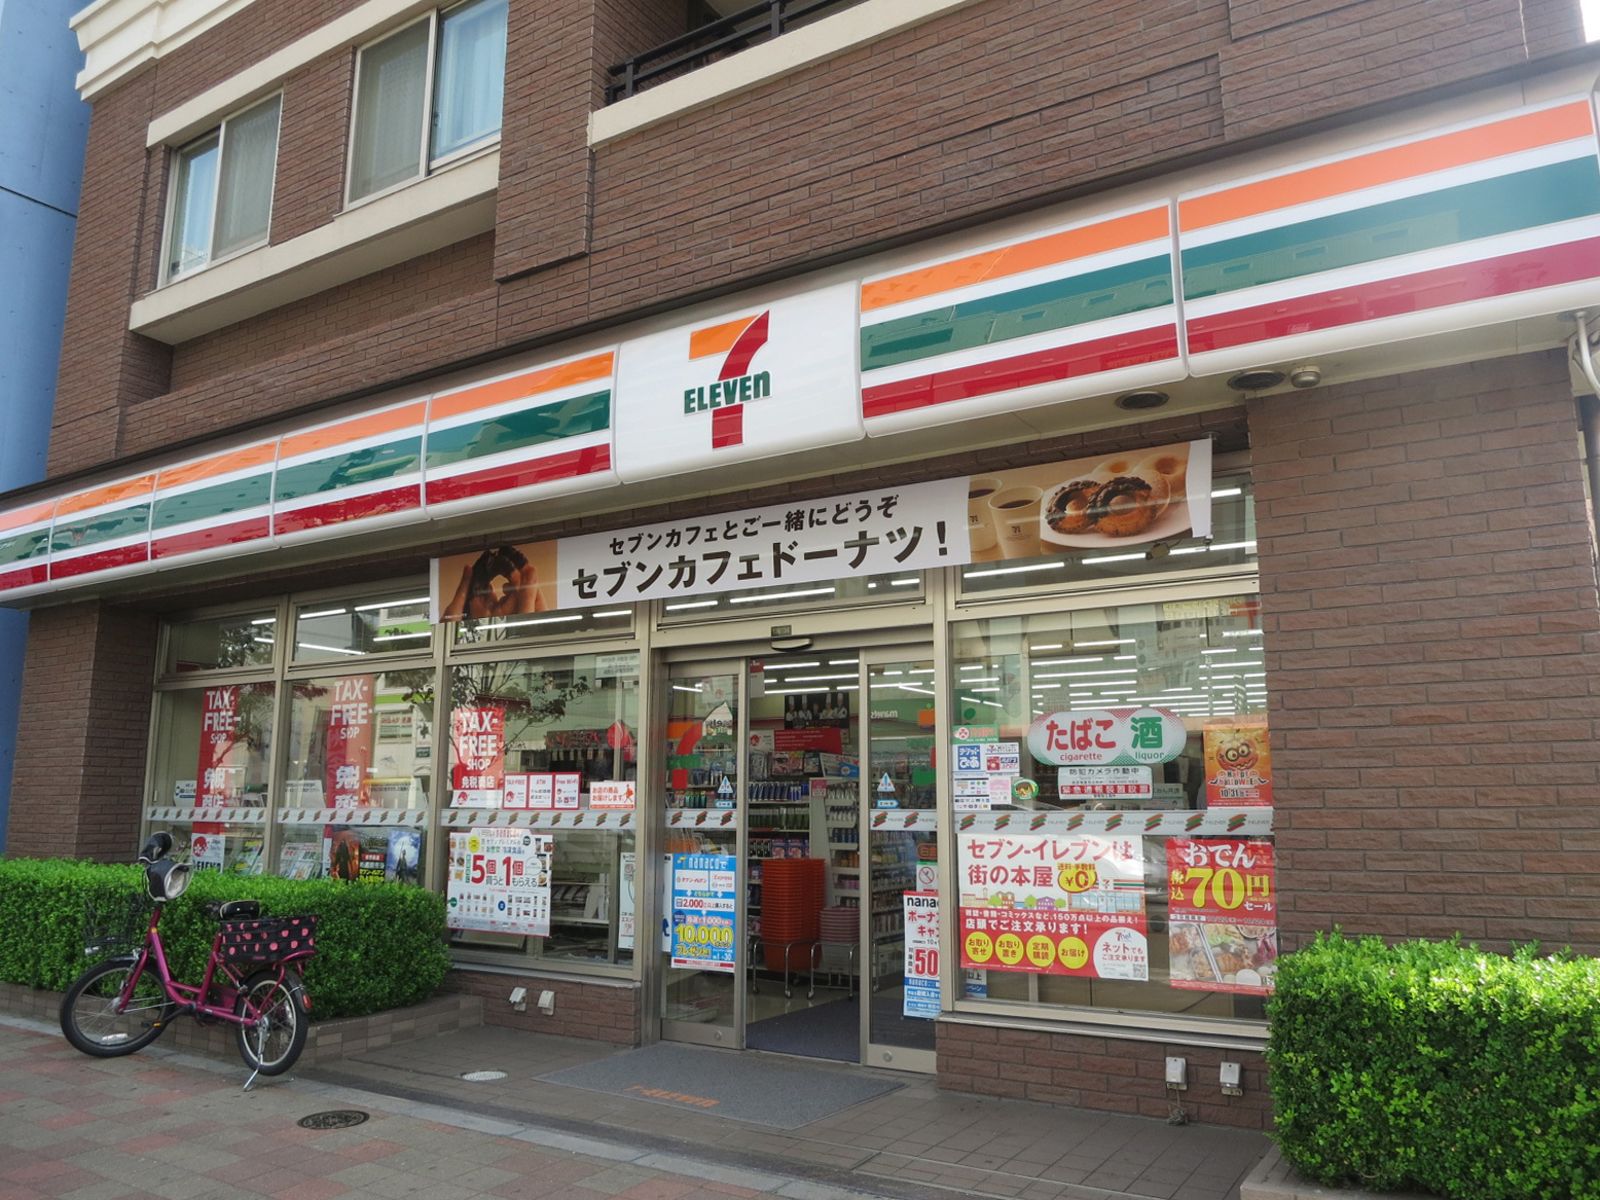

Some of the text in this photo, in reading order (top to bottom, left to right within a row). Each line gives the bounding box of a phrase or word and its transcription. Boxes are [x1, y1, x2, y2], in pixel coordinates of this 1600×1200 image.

[689, 310, 770, 449] 7
[609, 493, 899, 556] セブンカフェとご一緒にどうぞ
[459, 711, 499, 733] TAX-
[1046, 716, 1163, 751] たばこ 酒
[459, 734, 498, 757] FREE
[1060, 750, 1165, 763] cigarette liquor
[466, 758, 490, 771] SHOP
[967, 839, 1133, 861] セブン-イレブンは
[1183, 841, 1256, 869] おでん
[512, 877, 538, 888] もらえる
[968, 864, 1054, 887] 街の本屋
[907, 896, 939, 907] nana
[1244, 901, 1273, 912] セール
